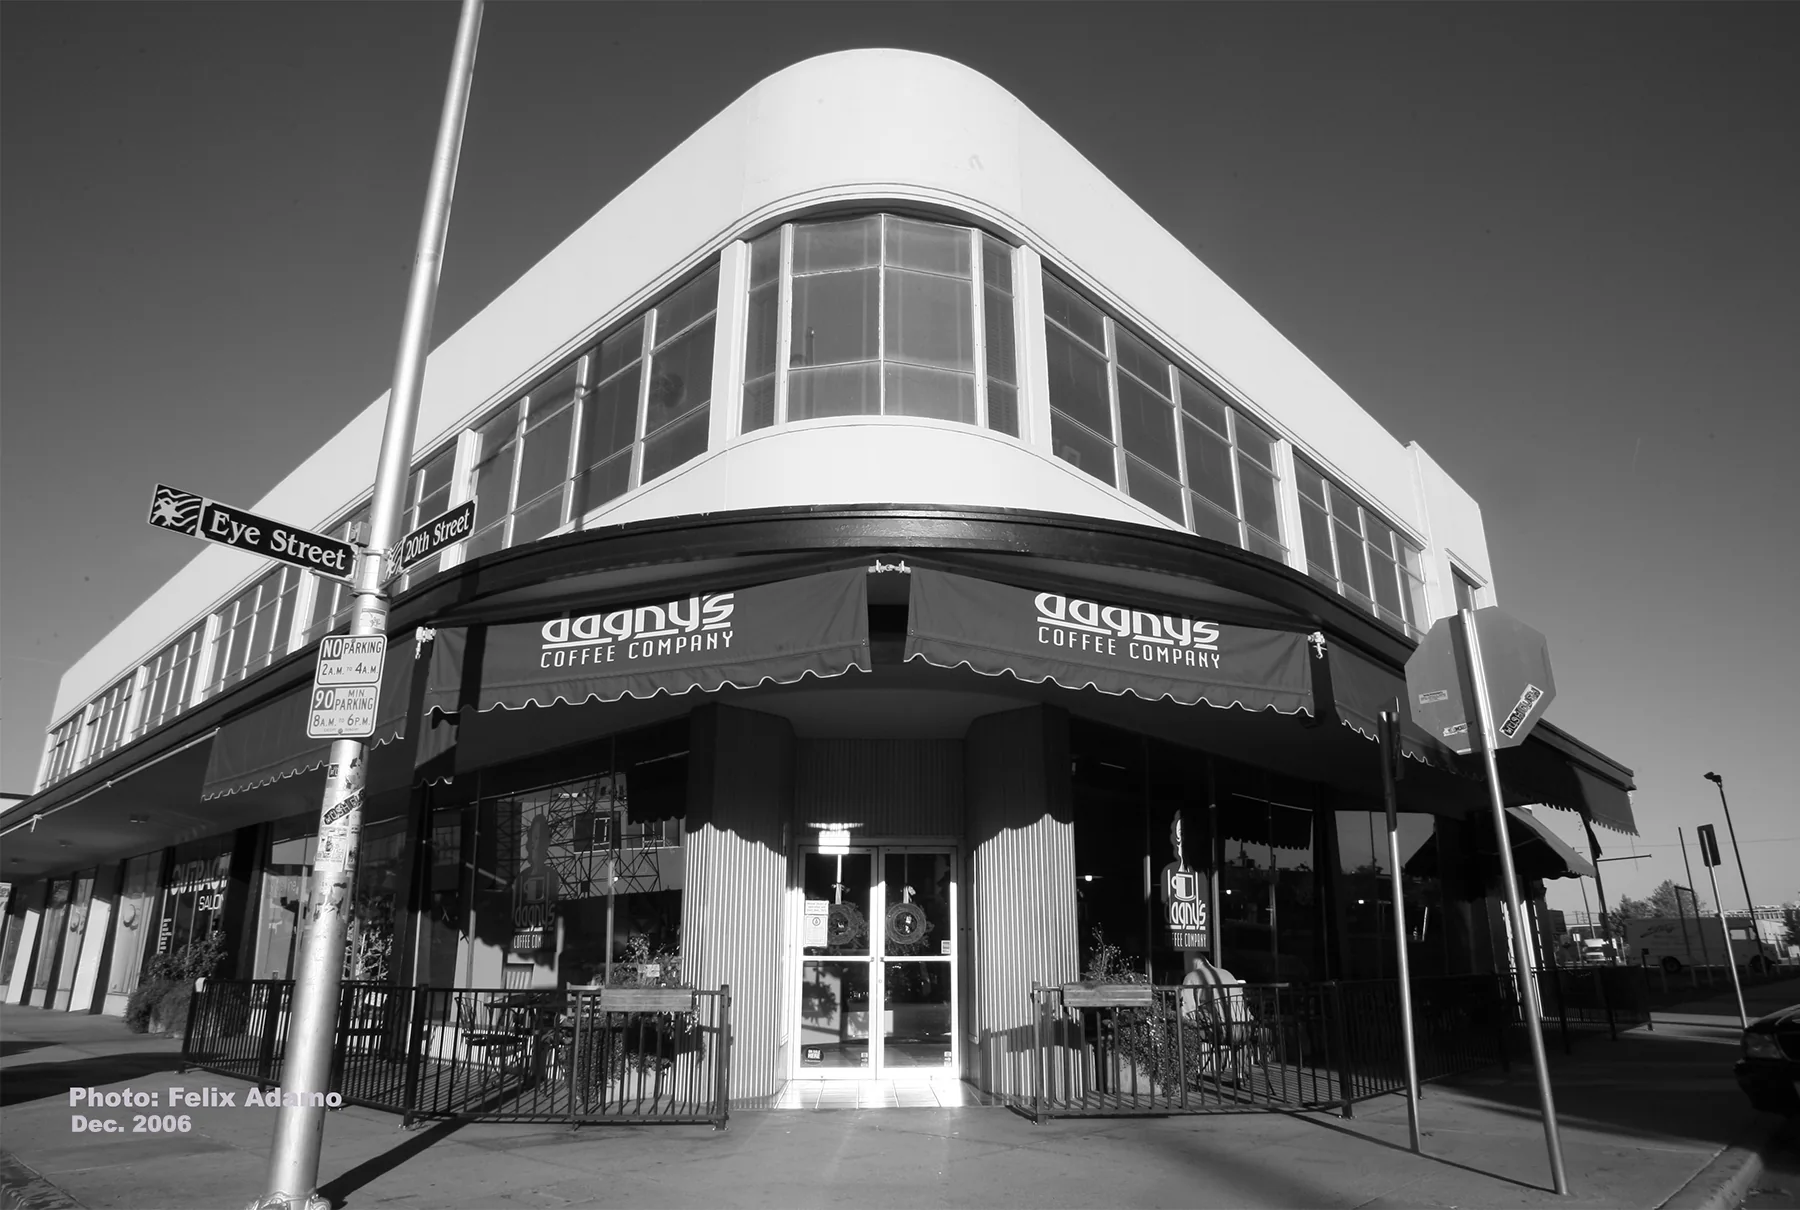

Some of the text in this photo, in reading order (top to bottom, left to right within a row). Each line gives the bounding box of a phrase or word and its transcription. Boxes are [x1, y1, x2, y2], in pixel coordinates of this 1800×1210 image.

[210, 510, 346, 570] Eye Street
[404, 508, 471, 563] 20th Street
[322, 638, 382, 659] NO PARKING
[540, 630, 734, 669] COFFEE COMPANY
[1038, 626, 1220, 669] COFFEE COMPANY
[314, 689, 334, 709] 90
[334, 697, 374, 711] PARKING
[513, 933, 531, 949] COFFEE
[1184, 932, 1206, 948] COMPANY
